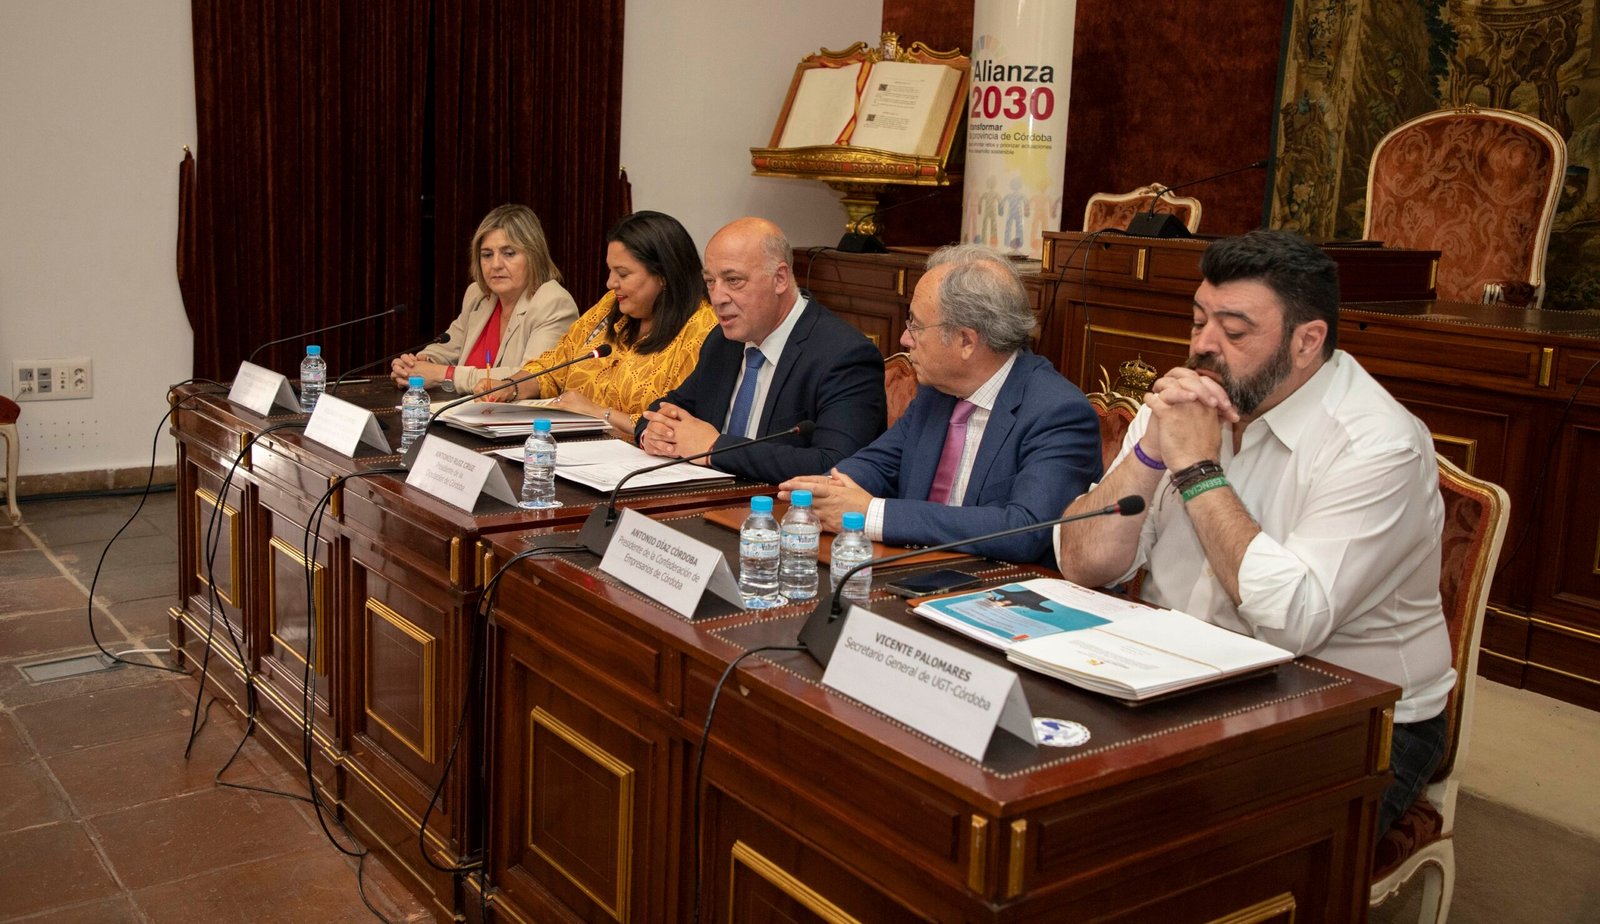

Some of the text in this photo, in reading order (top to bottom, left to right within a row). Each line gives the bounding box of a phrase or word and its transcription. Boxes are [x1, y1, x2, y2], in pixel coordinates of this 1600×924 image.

[974, 60, 1054, 83] Alianza
[971, 86, 1054, 120] 2030
[1001, 132, 1011, 140] de
[1013, 132, 1052, 142] Córdoba
[618, 536, 700, 583] Presidente de la Confederación de
[630, 528, 699, 566] ANTONIO DÍAZ CÓRDOBA
[624, 553, 683, 590] Empresarios de Córdoba
[844, 636, 992, 711] Secretario General de UGT-Córdoba
[875, 632, 972, 682] VICENTE PALOMARES
